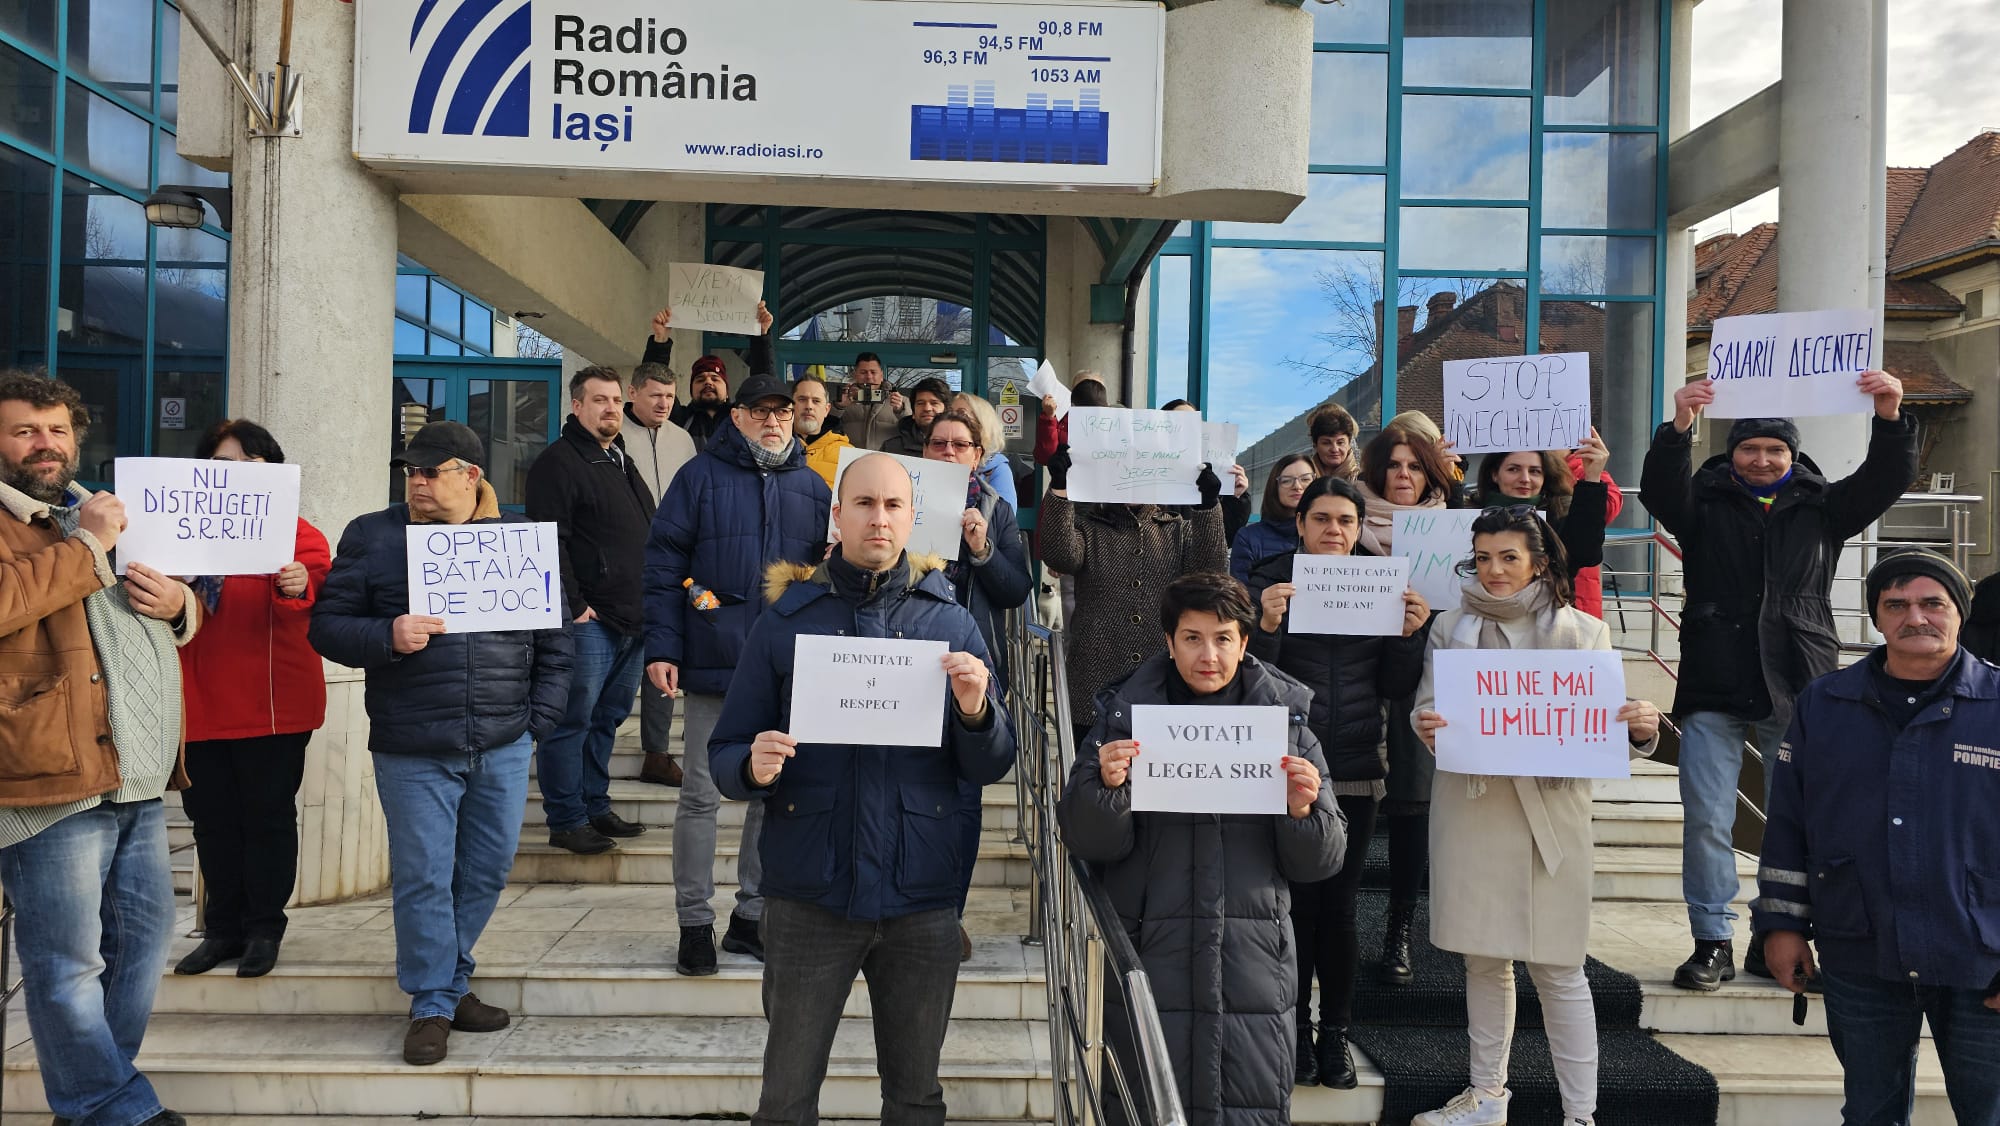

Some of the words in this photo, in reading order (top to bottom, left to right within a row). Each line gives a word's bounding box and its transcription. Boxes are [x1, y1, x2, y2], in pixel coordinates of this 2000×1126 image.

[554, 15, 687, 55] Radio
[1038, 21, 1073, 37] 90,8
[1078, 22, 1103, 36] FM
[979, 35, 1013, 52] 94,5
[1018, 36, 1043, 51] FM
[923, 50, 958, 66] 96,3
[963, 51, 988, 65] FM
[553, 59, 758, 101] România
[1031, 68, 1069, 83] 1053
[1074, 69, 1101, 83] AM
[553, 103, 633, 152] Iași
[685, 143, 823, 159] www.radioiasi.ro
[680, 266, 743, 292] VREM
[1711, 335, 1777, 380] SALARII
[1461, 355, 1567, 401] STOP
[193, 467, 228, 489] NU
[1303, 566, 1319, 575] NU
[1307, 583, 1331, 592] UNEI
[1336, 584, 1375, 593] ISTORII
[1379, 585, 1393, 594] DE
[428, 591, 468, 615] DE
[1323, 600, 1334, 609] 82
[1336, 600, 1350, 609] DE
[1352, 601, 1374, 610] ANI!
[832, 652, 913, 666] DEMNITATE
[866, 677, 876, 688] și
[1477, 670, 1508, 696] NU
[1517, 670, 1544, 696] NE
[1553, 665, 1594, 697] MAI
[840, 698, 900, 710] RESPECT
[1167, 725, 1254, 745] VOTAȚI
[1147, 762, 1225, 779] LEGEA
[1230, 763, 1275, 779] SRR
